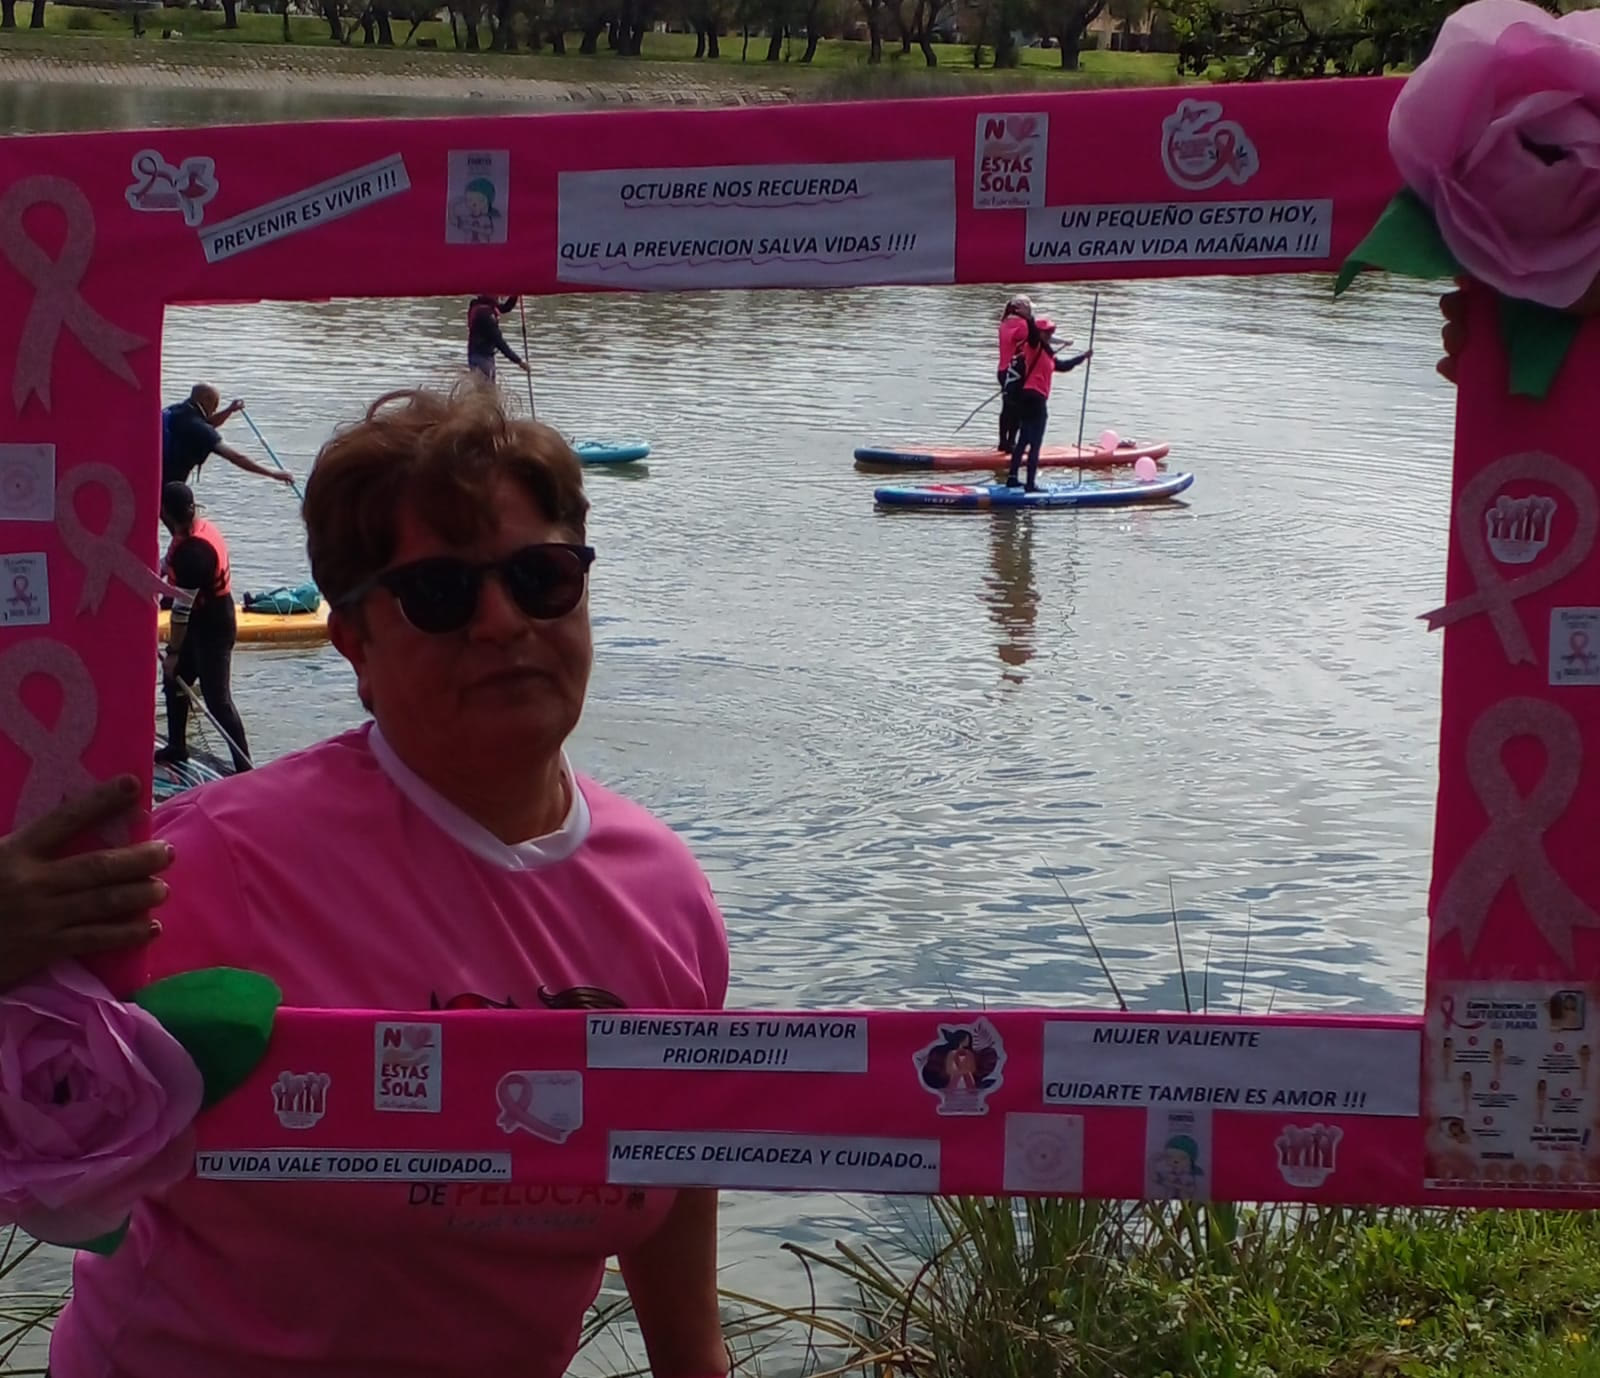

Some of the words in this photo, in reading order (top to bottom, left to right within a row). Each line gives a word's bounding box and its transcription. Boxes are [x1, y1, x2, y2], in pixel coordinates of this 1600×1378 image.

[620, 182, 708, 201] OCTUBRE
[712, 180, 753, 198] NOS
[757, 178, 859, 197] RECUERDA
[979, 173, 1031, 193] SOLA
[213, 210, 298, 254] PREVENIR
[301, 201, 322, 222] ES
[325, 181, 373, 211] VIVIR
[377, 169, 398, 193] !!!
[1061, 211, 1090, 228] UN
[1096, 205, 1194, 228] PEQUEÑO
[1199, 207, 1264, 226] GESTO
[1269, 205, 1318, 226] HOY,
[560, 241, 601, 260] QUE
[605, 241, 627, 258] LA
[632, 237, 755, 258] PREVENCION
[757, 236, 818, 256] SALVA
[824, 235, 881, 253] VIDAS
[887, 233, 918, 252] !!!!
[1028, 241, 1071, 258] UNA
[1077, 239, 1136, 258] GRAN
[1142, 238, 1188, 255] VIDA
[1193, 235, 1288, 254] MAÑANA
[1295, 233, 1319, 252] !!!
[590, 1019, 614, 1036] TU
[619, 1021, 719, 1038] BIENESTAR
[729, 1022, 750, 1038] ES
[755, 1022, 779, 1038] TU
[784, 1022, 857, 1039] MAYOR
[1092, 1027, 1160, 1046] MUJER
[1166, 1029, 1261, 1048] VALIENTE
[662, 1047, 789, 1066] PRIORIDAD!!!
[379, 1078, 429, 1099] SOLA
[1046, 1082, 1143, 1102] CUIDARTE
[1148, 1085, 1238, 1105] TAMBIEN
[1244, 1088, 1267, 1105] ES
[1272, 1089, 1337, 1108] AMOR
[1342, 1090, 1367, 1109] !!!
[199, 1156, 224, 1172] TU
[228, 1156, 271, 1173] VIDA
[276, 1157, 322, 1174] VALE
[326, 1157, 379, 1175] TODO
[383, 1158, 403, 1174] EL
[611, 1144, 696, 1162] MERECES
[700, 1147, 814, 1165] DELICADEZA
[819, 1150, 832, 1166] Y
[408, 1183, 448, 1206] DE
